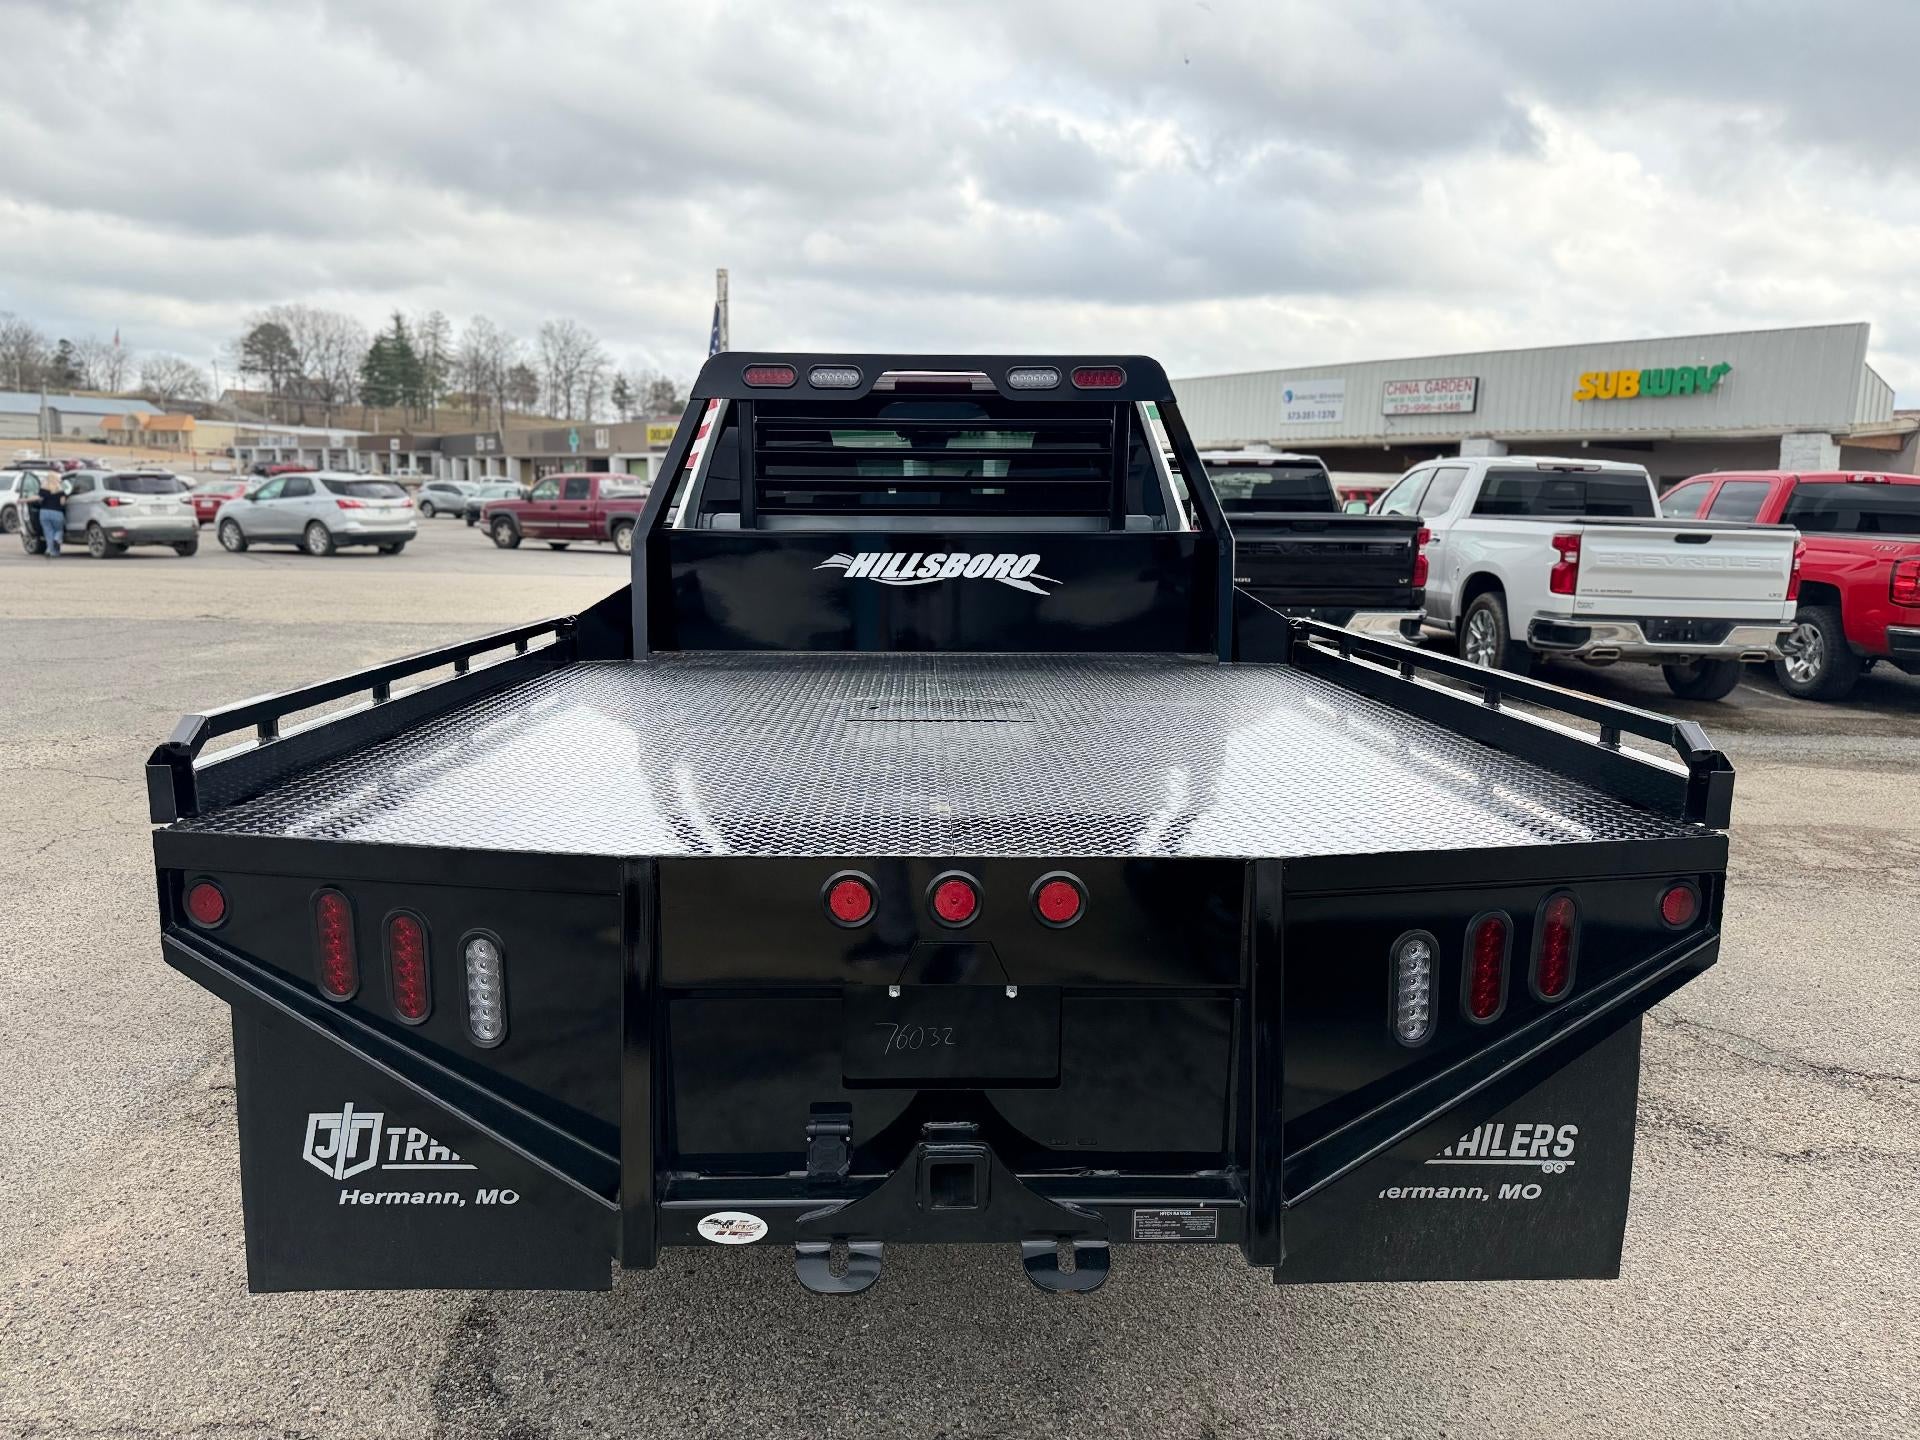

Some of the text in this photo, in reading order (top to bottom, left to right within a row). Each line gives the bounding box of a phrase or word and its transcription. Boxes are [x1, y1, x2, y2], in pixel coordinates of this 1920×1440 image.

[1387, 379, 1473, 396] CHINA GARDEN
[1573, 362, 1732, 401] SUBWAY
[843, 552, 1041, 579] HILLSBORO
[1597, 552, 1781, 571] CHEVROLET
[874, 1022, 956, 1055] 76032
[339, 1188, 520, 1208] Hermann, MO
[1378, 1183, 1542, 1202] ermann, MO
